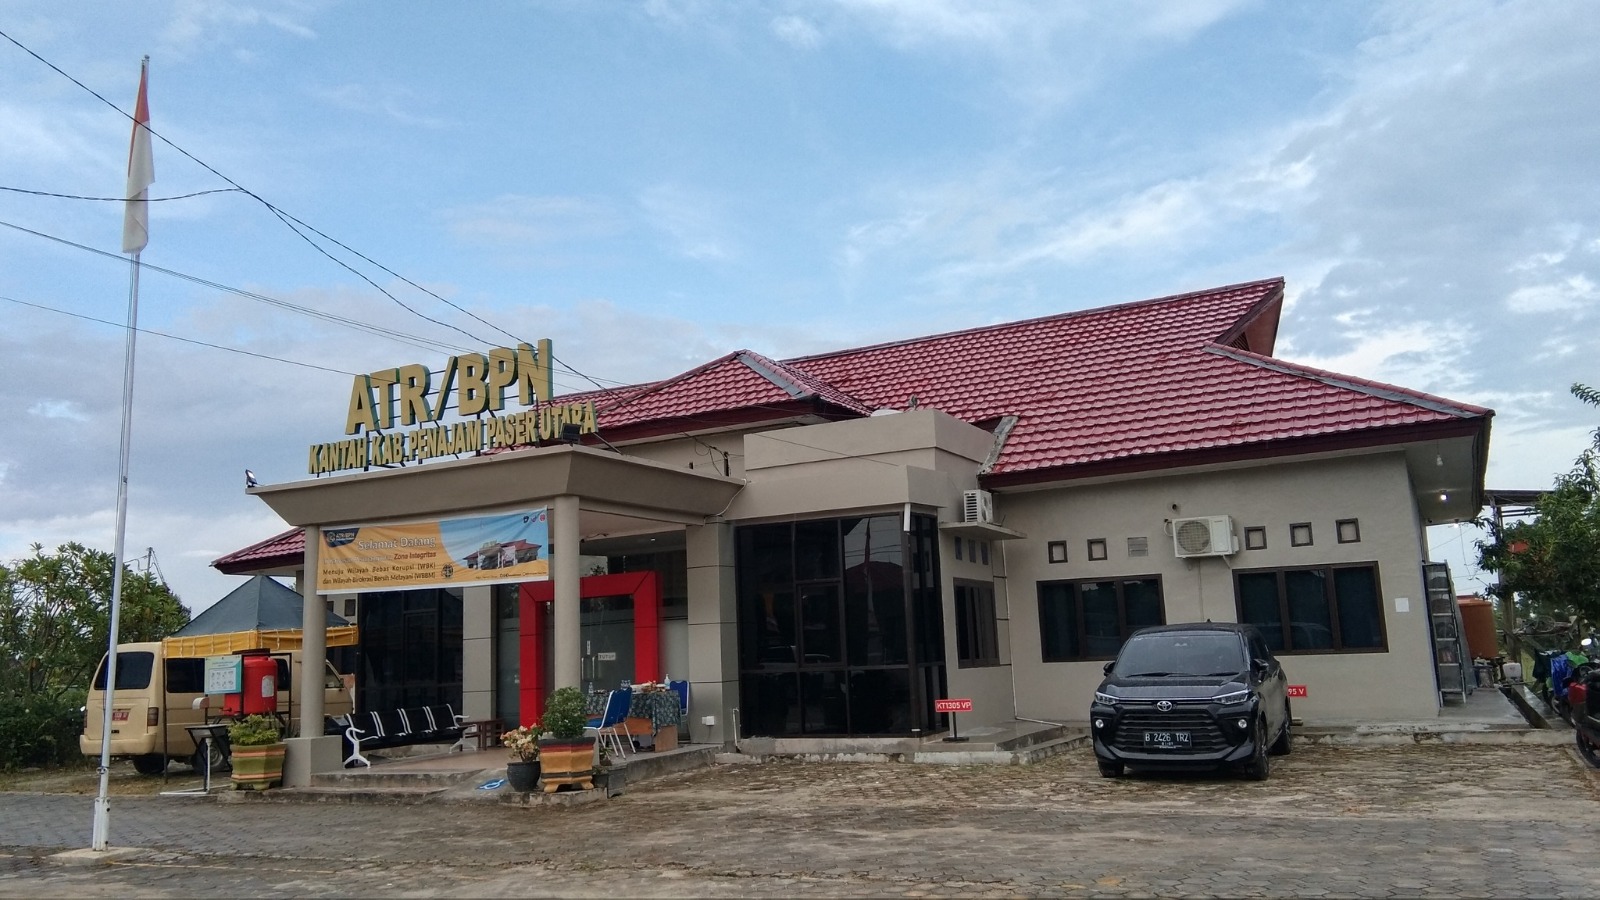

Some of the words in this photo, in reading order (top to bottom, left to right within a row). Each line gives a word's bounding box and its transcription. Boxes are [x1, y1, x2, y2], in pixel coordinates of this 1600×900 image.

[346, 338, 553, 434] ATR/BPN
[309, 435, 371, 474] KANTAH
[408, 419, 484, 462] PENAJAM
[486, 410, 540, 450] PASER
[539, 400, 599, 441] UTARA
[358, 539, 398, 550] Selamat
[400, 537, 436, 548] Datang
[409, 551, 437, 561] Integritas
[347, 567, 369, 575] Wilayah
[392, 564, 415, 572] Korupsi
[1145, 733, 1151, 742] B
[1153, 733, 1172, 742] 2426
[1175, 733, 1189, 742] TRZ
